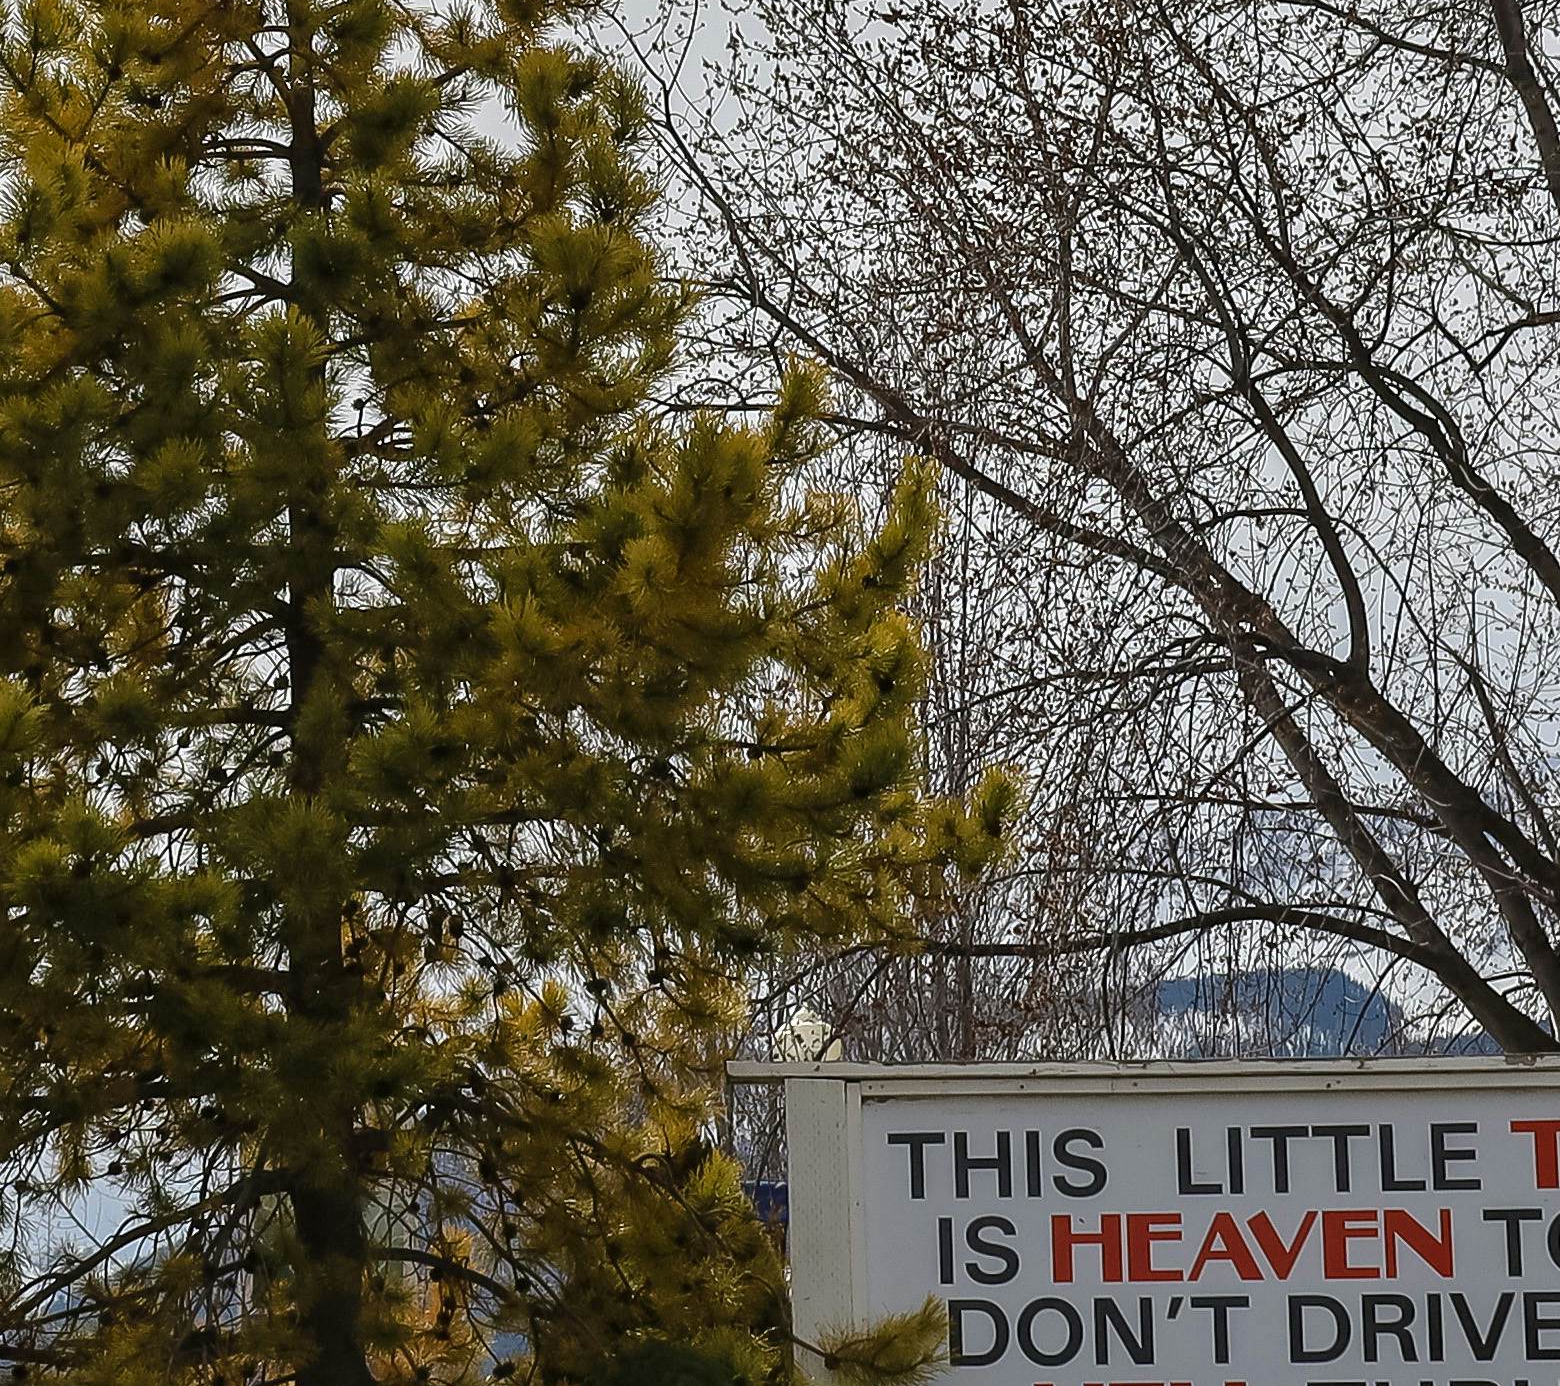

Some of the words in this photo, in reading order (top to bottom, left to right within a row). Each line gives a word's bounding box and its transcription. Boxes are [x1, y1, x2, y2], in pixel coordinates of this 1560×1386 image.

[887, 1127, 1108, 1199] THIS
[1176, 1122, 1481, 1194] LITTLE
[938, 1215, 1020, 1285] IS
[1050, 1208, 1454, 1283] HEAVEN
[947, 1295, 1250, 1366] DON'T
